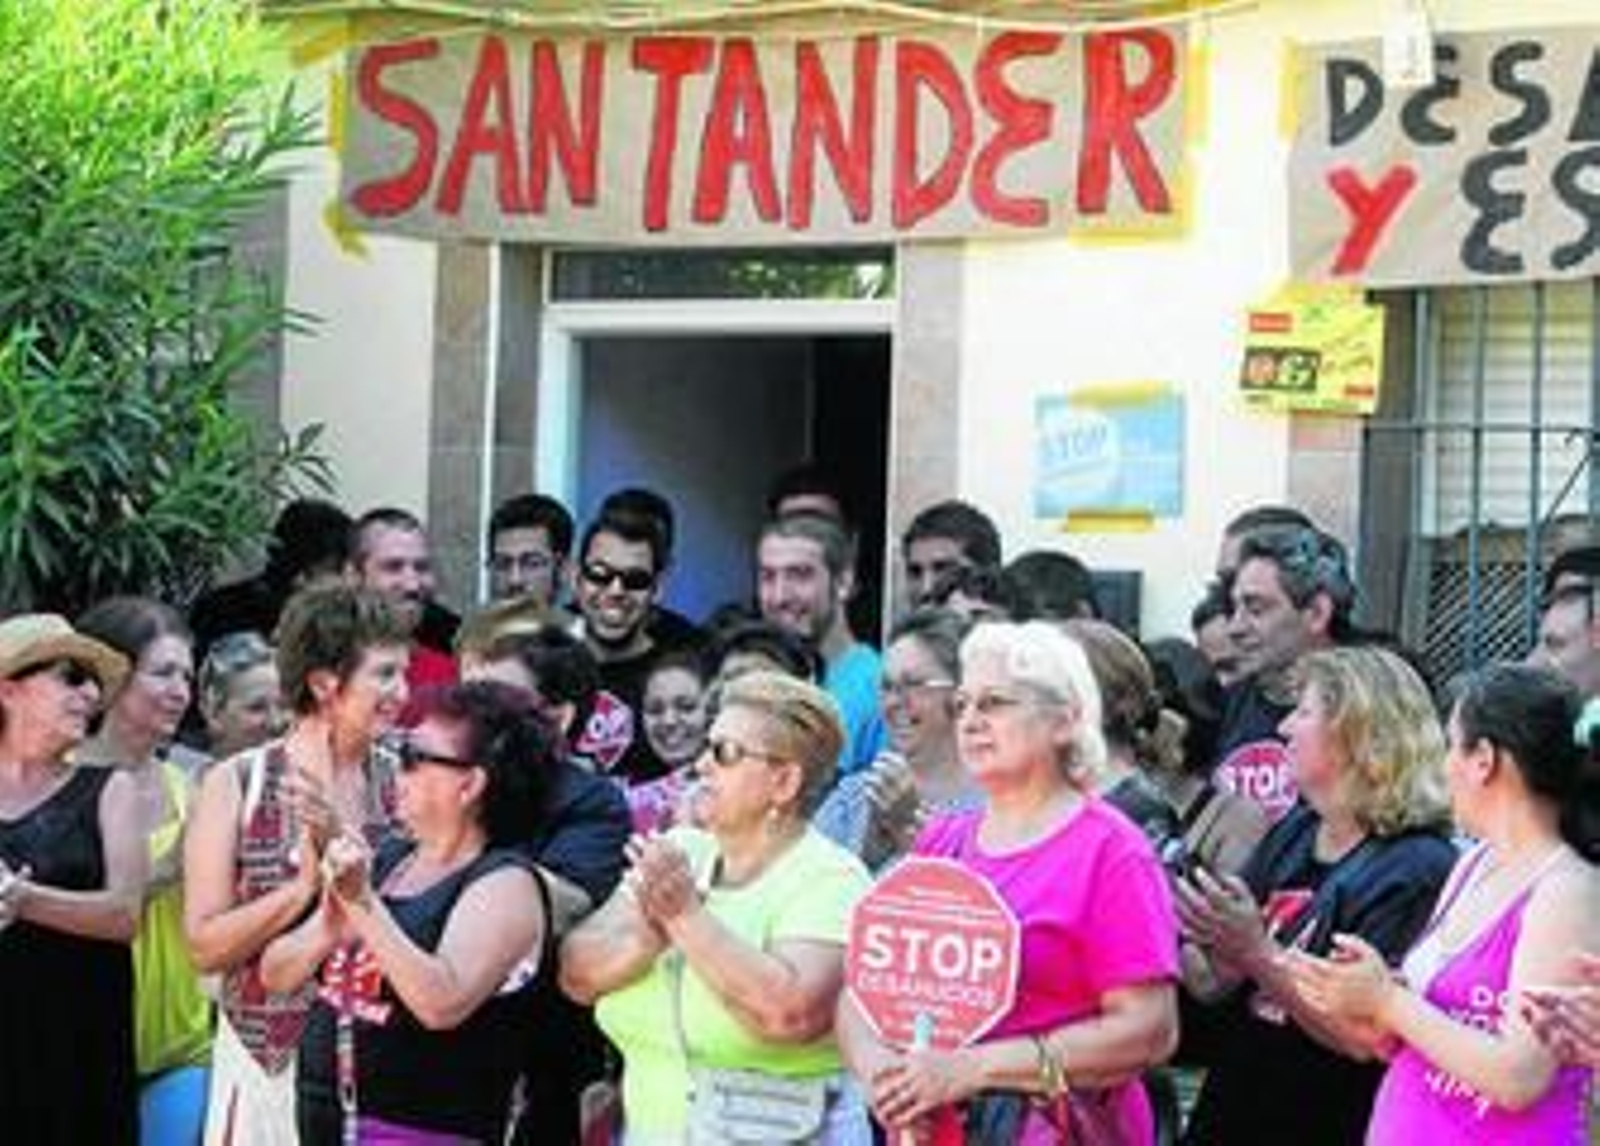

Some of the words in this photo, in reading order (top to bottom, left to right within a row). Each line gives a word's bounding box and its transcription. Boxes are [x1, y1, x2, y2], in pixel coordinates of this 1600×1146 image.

[351, 29, 1178, 230] SANTANDER
[1327, 166, 1417, 275] Y
[1460, 147, 1600, 275] ES
[860, 924, 1003, 984] STOP
